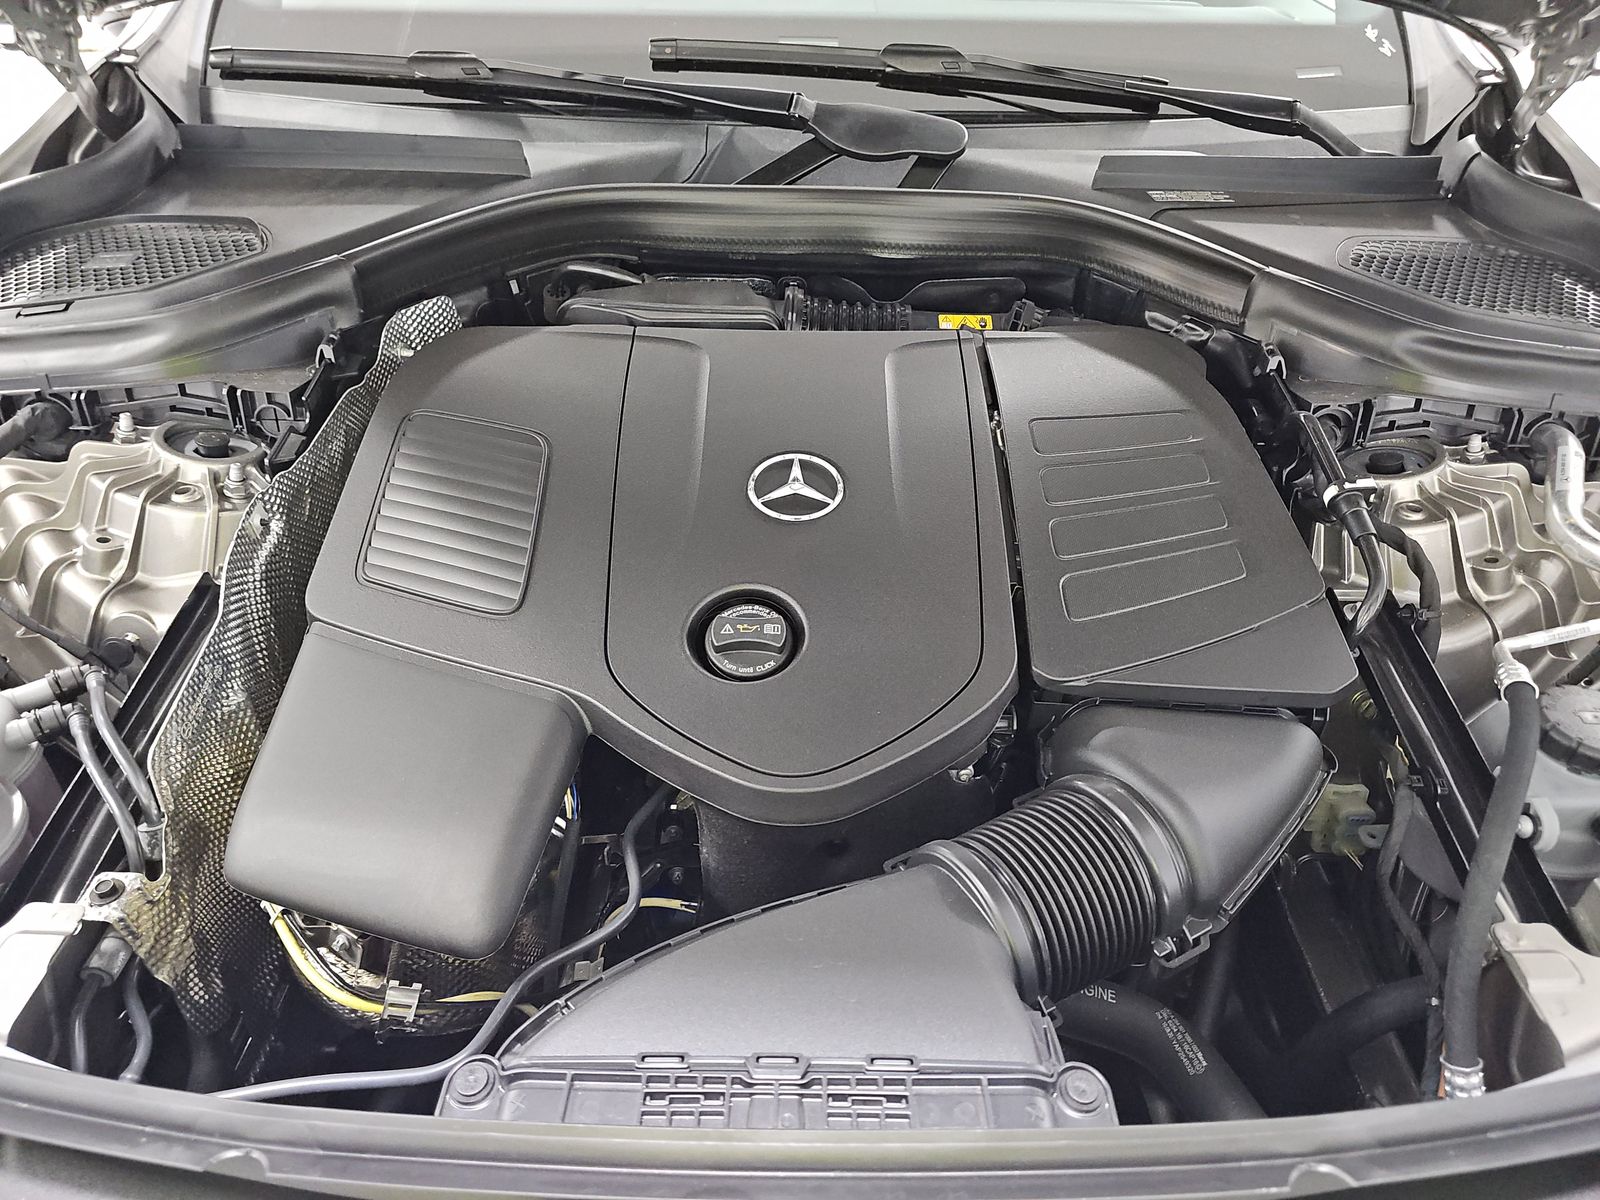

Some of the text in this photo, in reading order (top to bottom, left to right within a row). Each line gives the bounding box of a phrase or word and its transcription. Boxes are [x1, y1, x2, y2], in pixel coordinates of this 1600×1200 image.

[722, 660, 776, 673] Turn until CLICK
[1080, 984, 1116, 1003] GINE
